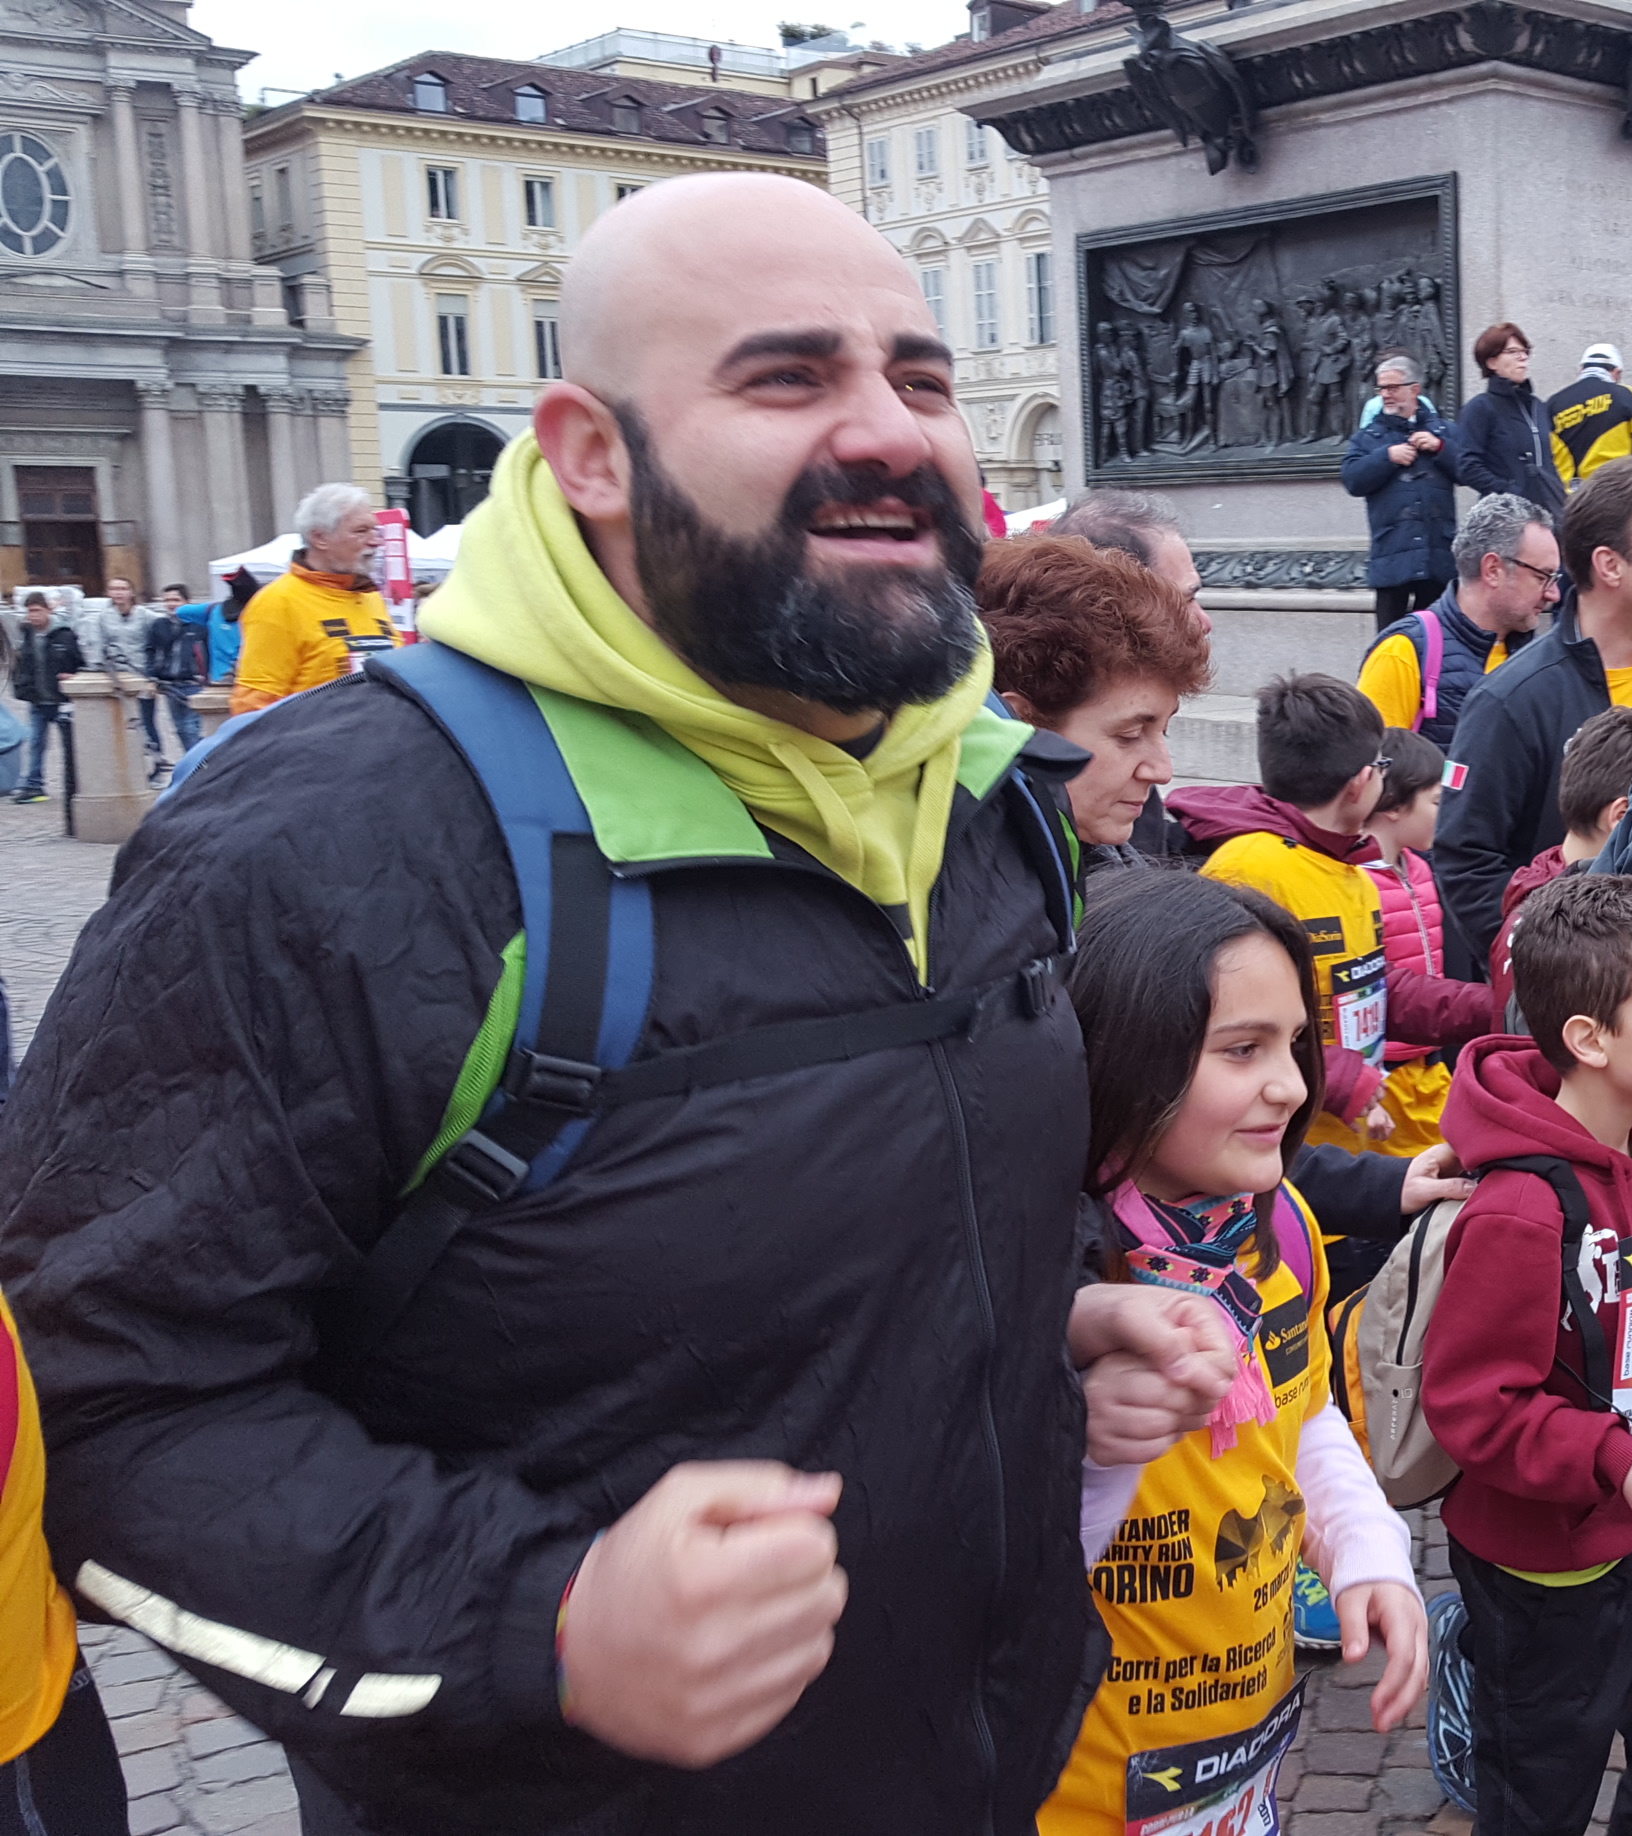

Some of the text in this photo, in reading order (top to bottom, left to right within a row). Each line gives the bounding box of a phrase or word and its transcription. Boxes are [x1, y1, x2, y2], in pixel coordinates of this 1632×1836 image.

[1274, 1387, 1298, 1408] base
[1117, 1509, 1190, 1542] TANDER
[1100, 1537, 1194, 1562] ARITY RUN
[1093, 1562, 1195, 1605] ORINO
[1253, 1583, 1268, 1612] 26
[1107, 1626, 1276, 1683] Corri per la Ricerca
[1128, 1664, 1267, 1715] e la Solidarietà
[1195, 1691, 1301, 1784] DIADORA
[1257, 1801, 1271, 1827] 2017
